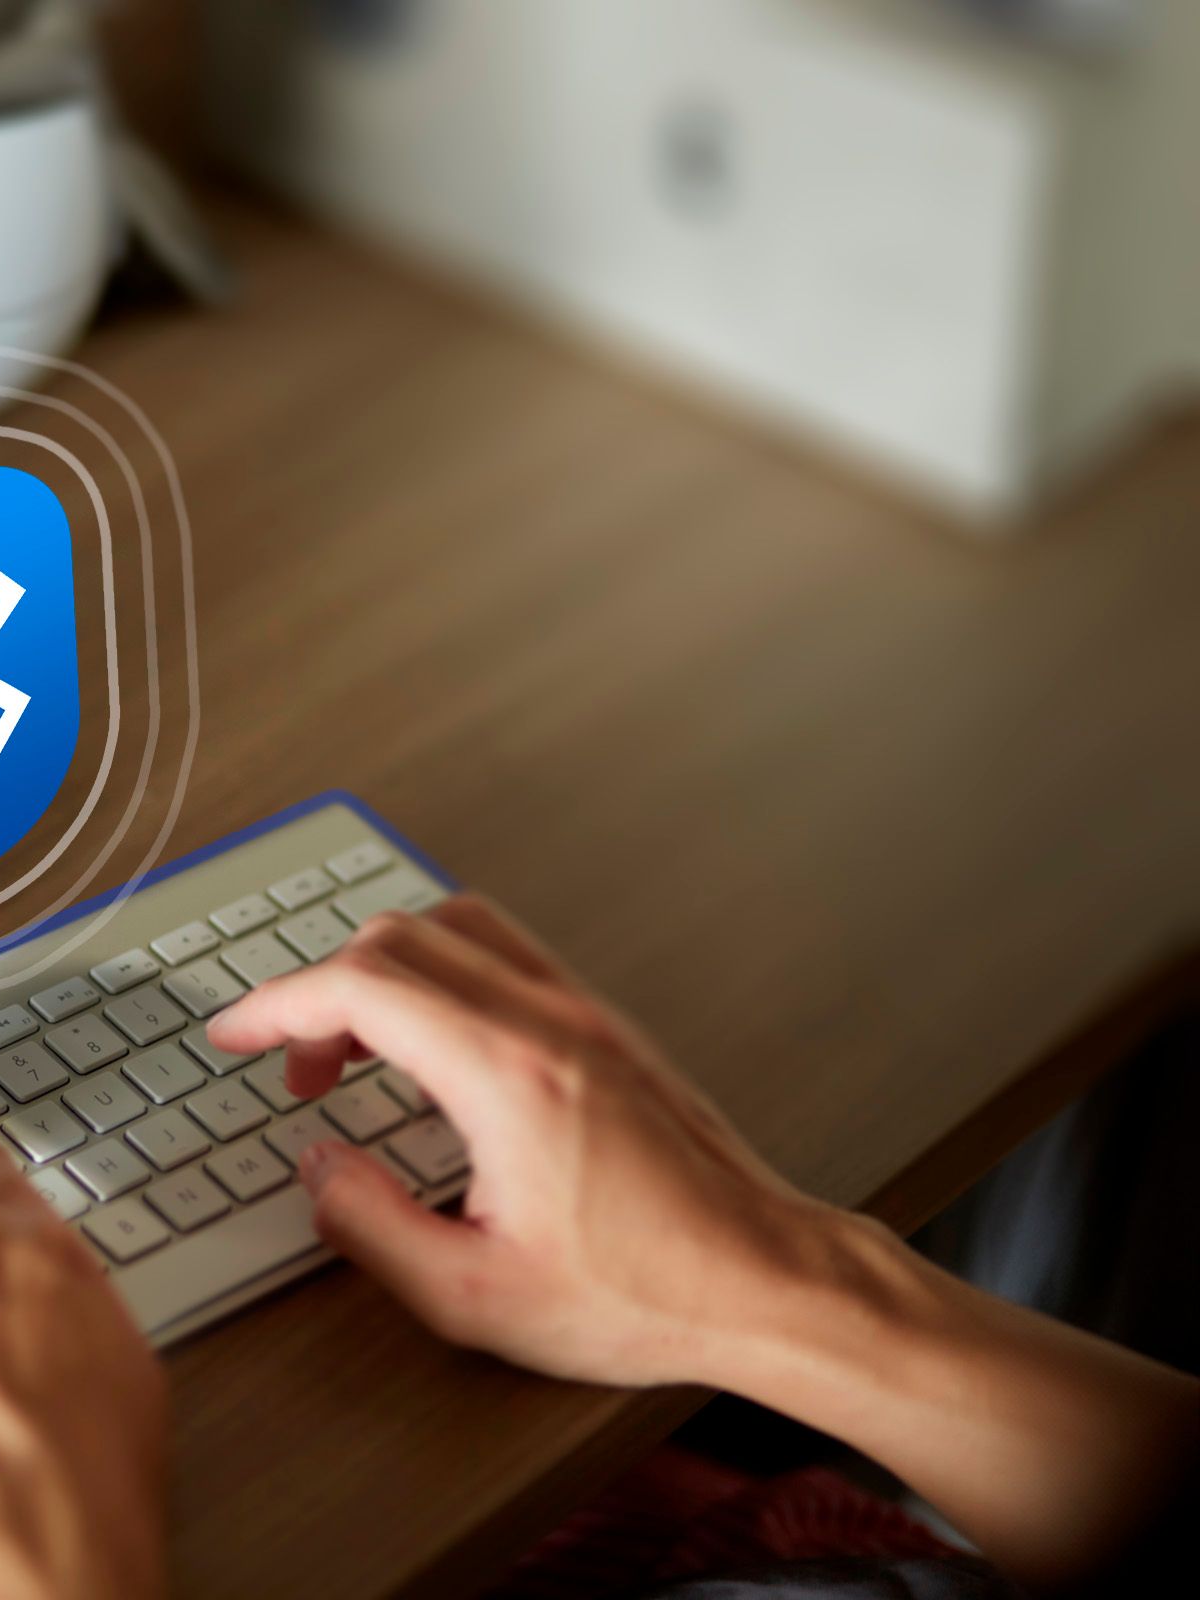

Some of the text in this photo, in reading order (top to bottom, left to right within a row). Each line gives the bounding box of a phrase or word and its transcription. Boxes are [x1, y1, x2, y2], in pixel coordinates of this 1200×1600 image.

[146, 1014, 158, 1026] 9
[88, 1041, 101, 1053] 8
[12, 1055, 27, 1067] &
[27, 1069, 39, 1082] 7
[94, 1091, 112, 1106] U
[218, 1100, 237, 1114] K
[34, 1119, 50, 1134] Y
[163, 1129, 176, 1143] J
[98, 1158, 117, 1173] H
[237, 1158, 260, 1174] M
[177, 1188, 198, 1203] N
[117, 1219, 135, 1234] B
